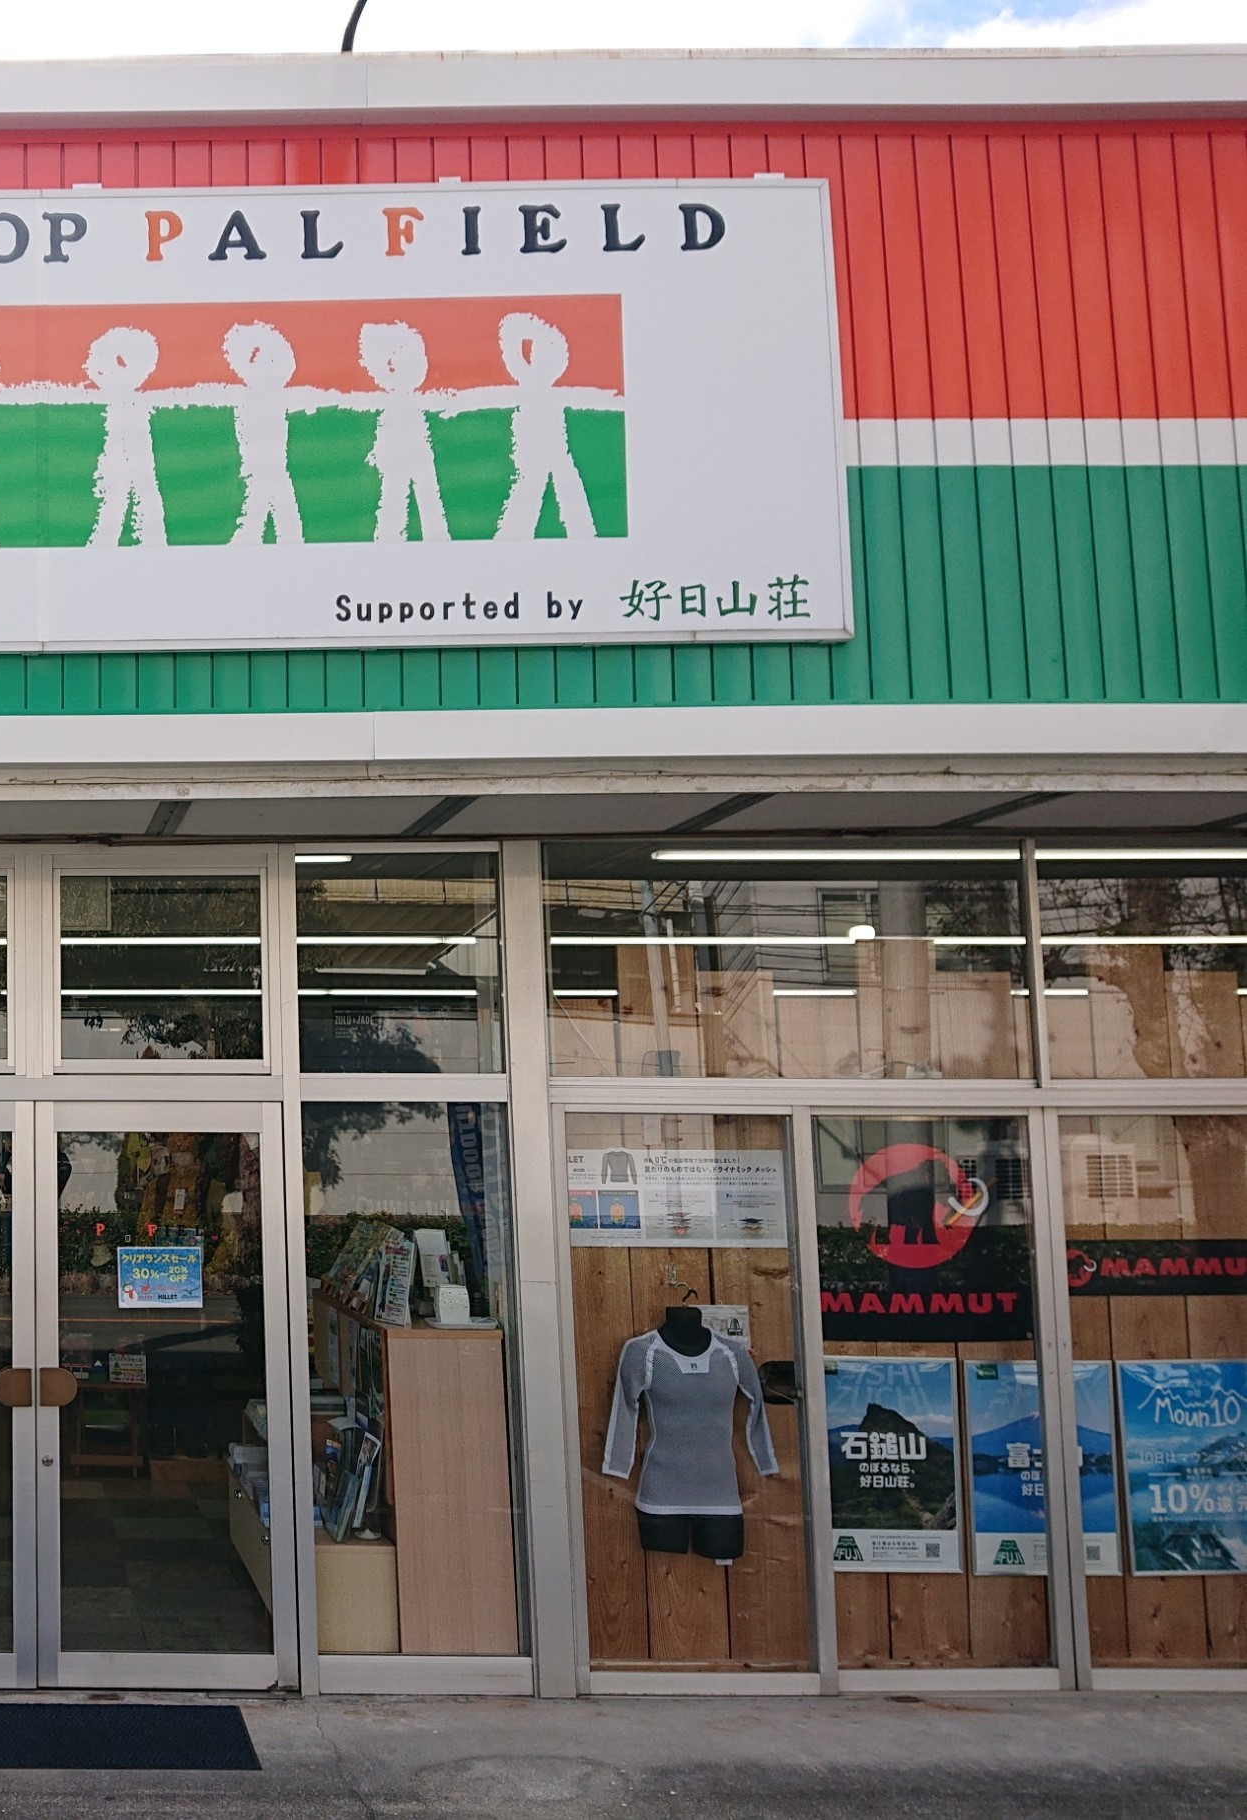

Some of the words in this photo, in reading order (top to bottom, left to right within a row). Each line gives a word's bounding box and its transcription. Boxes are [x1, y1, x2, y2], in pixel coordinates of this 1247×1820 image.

[145, 202, 726, 262] PALFIELD
[335, 592, 520, 623] Supported
[546, 592, 584, 621] by
[619, 575, 811, 621] 好日山荘
[121, 1253, 196, 1264] クリアランスセール
[819, 1291, 1018, 1315] MAMMUT
[840, 1431, 927, 1460] 石鎚山
[1148, 1484, 1214, 1515] 10%
